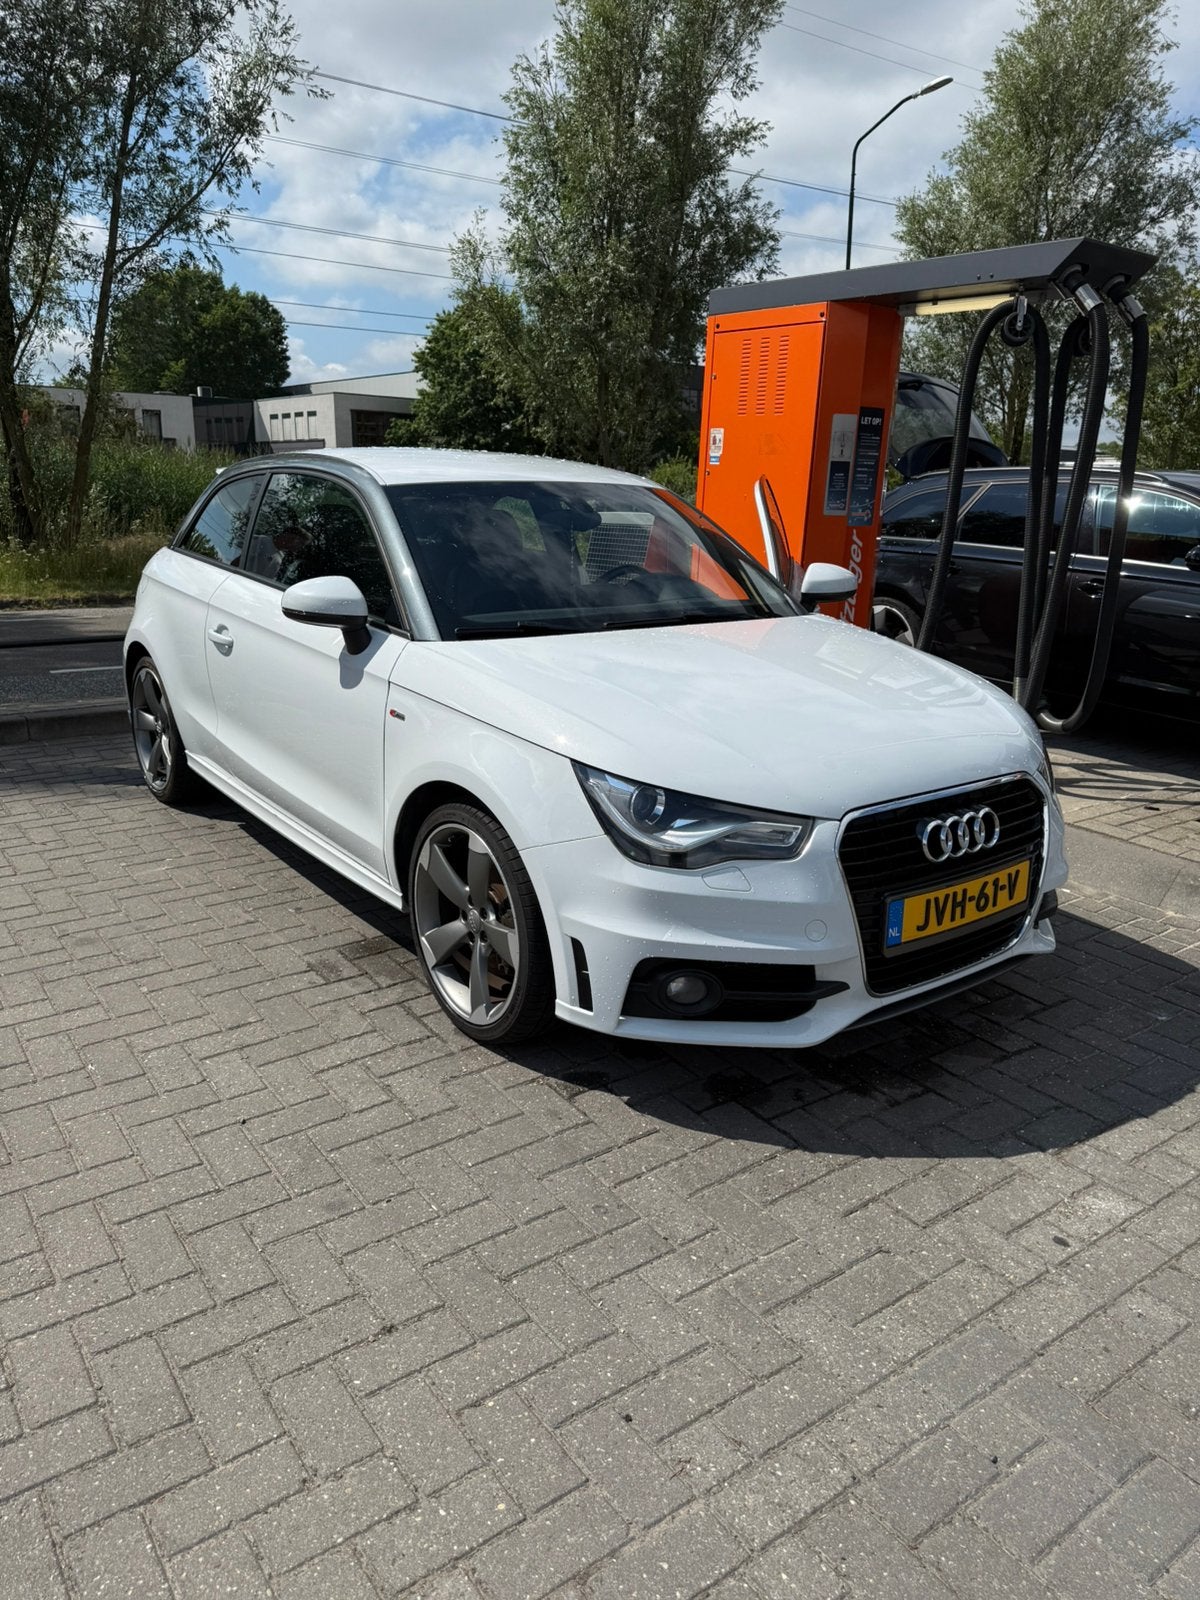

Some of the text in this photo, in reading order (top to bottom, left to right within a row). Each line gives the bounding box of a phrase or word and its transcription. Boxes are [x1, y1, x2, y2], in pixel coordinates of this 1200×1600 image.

[860, 416, 882, 426] LET OP!
[916, 869, 1021, 932] JVH-61-V
[888, 928, 900, 938] NL
